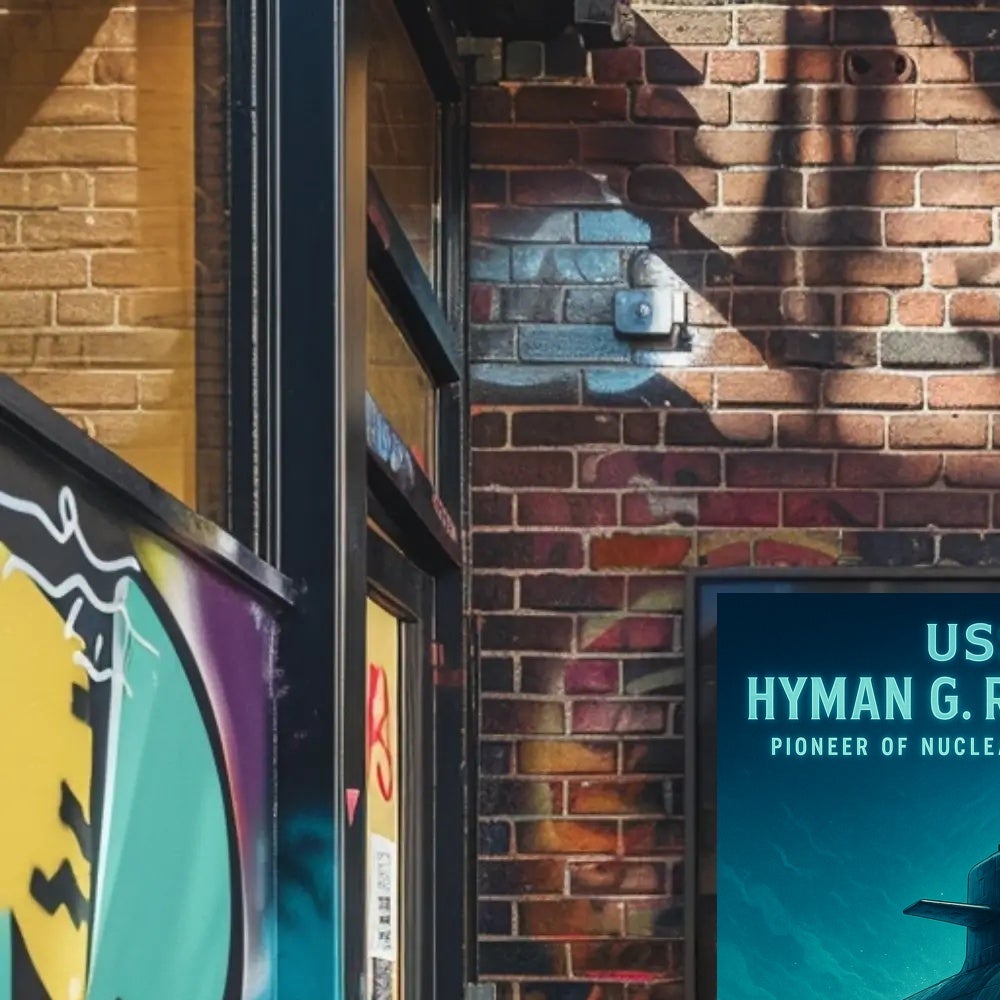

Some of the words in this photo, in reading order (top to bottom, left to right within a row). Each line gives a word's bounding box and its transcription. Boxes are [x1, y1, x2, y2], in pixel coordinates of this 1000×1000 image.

[747, 676, 913, 720] HYMAN
[930, 676, 972, 720] G.
[771, 737, 868, 757] PIONEER
[881, 737, 908, 757] OF
